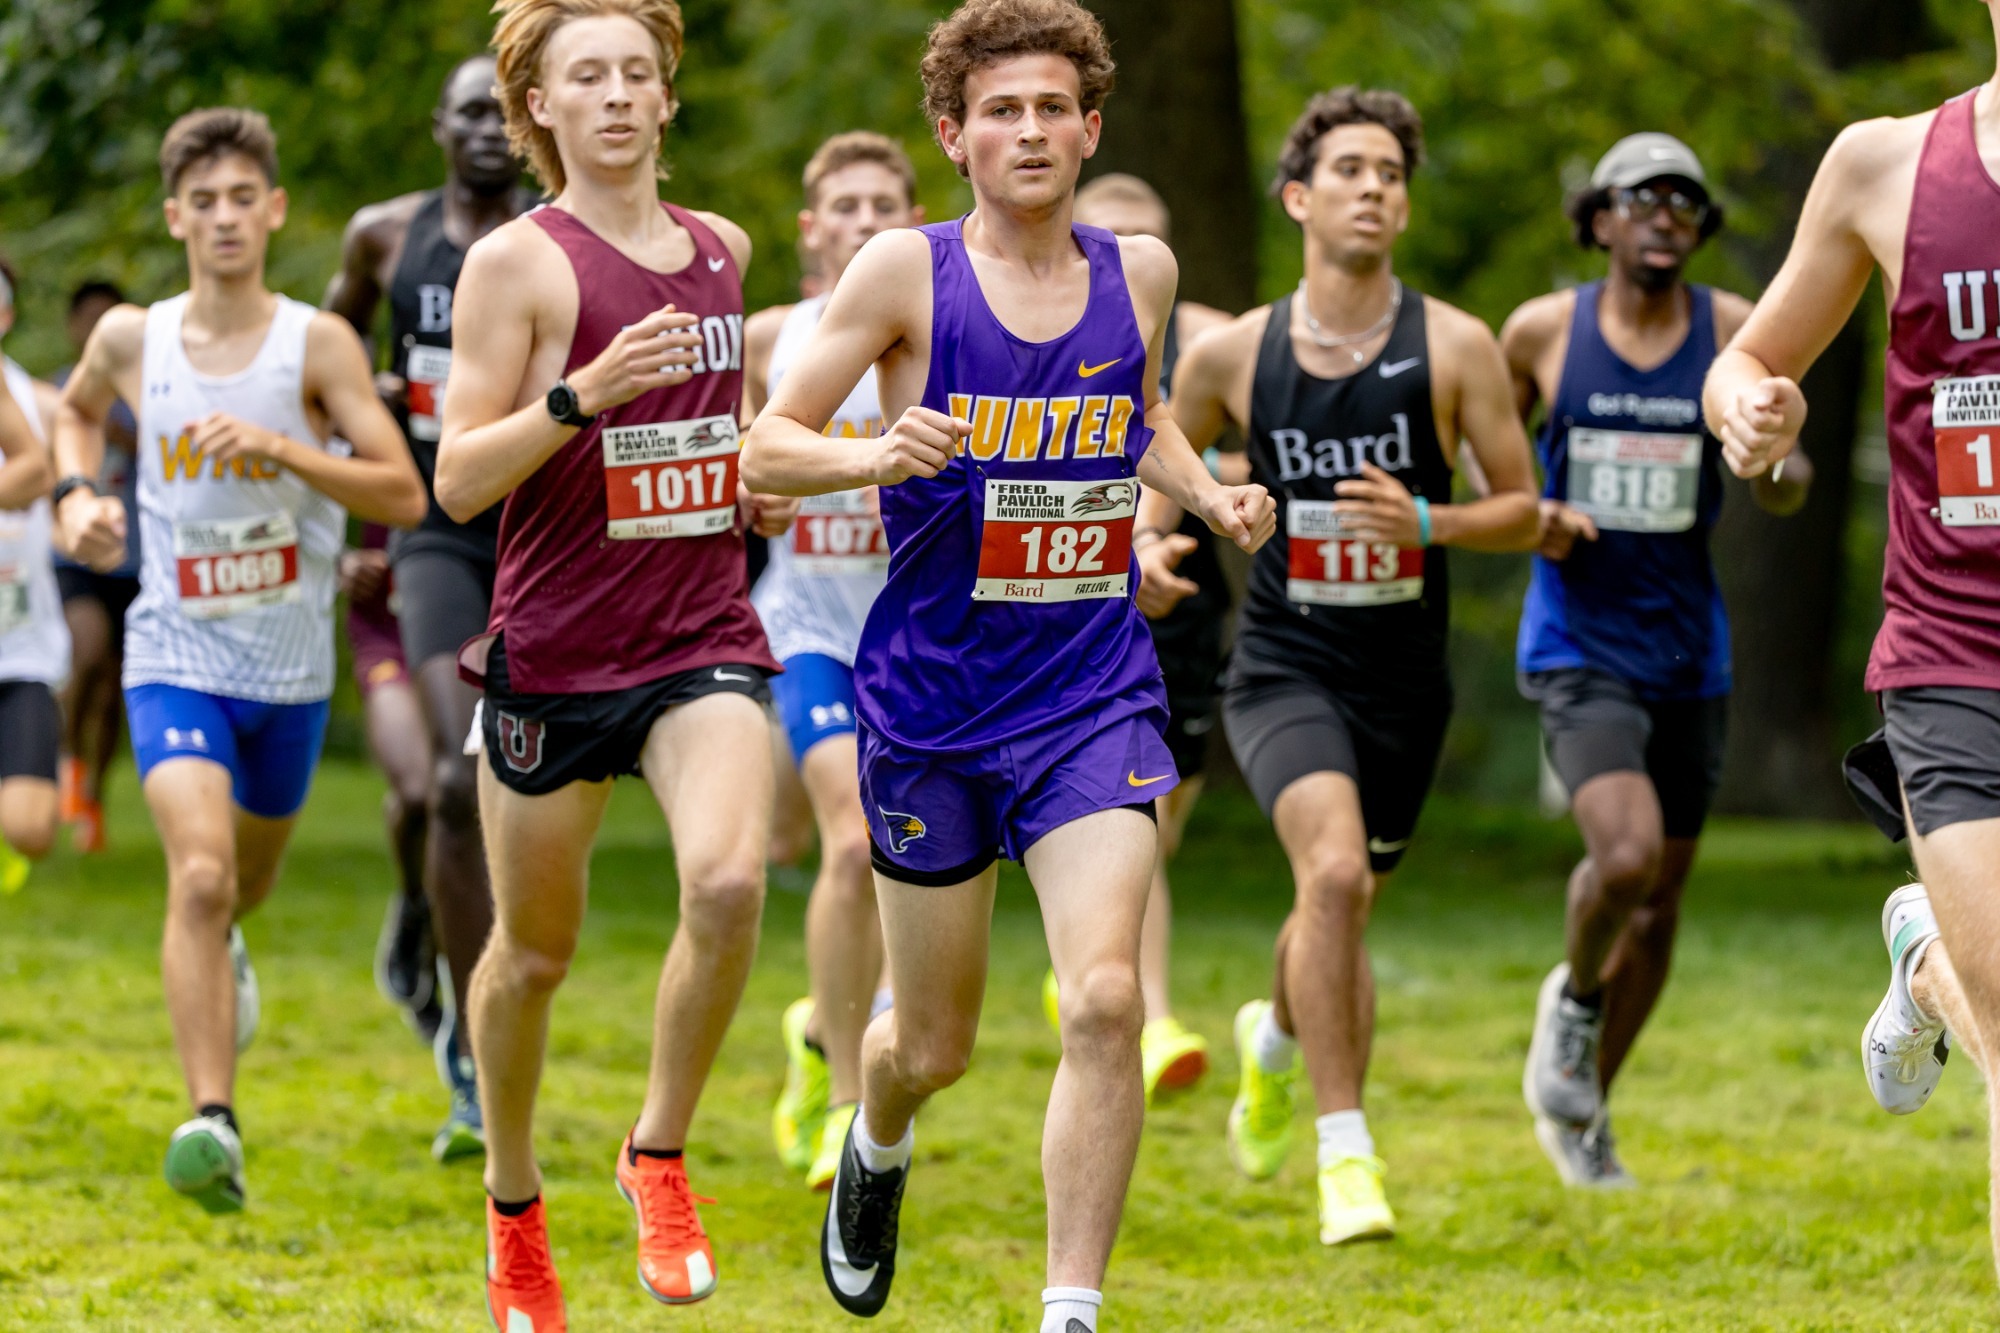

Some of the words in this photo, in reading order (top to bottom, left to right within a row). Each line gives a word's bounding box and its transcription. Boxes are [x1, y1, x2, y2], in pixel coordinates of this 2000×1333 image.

[1942, 269, 2000, 342] U
[1947, 393, 2000, 408] PAVLI
[1947, 409, 2000, 422] INVITATI
[614, 429, 659, 440] FRED
[614, 436, 677, 451] PAVLICH
[1269, 412, 1415, 482] Bard
[615, 449, 679, 462] INVITATIONAL
[631, 461, 727, 511] 1017
[998, 484, 1047, 494] FRED
[1589, 465, 1677, 511] 818
[997, 495, 1065, 507] PAVLICH
[996, 507, 1066, 518] INVITATIONAL
[635, 519, 673, 535] Bard
[1020, 525, 1108, 573] 182
[1316, 540, 1399, 582] 113
[191, 550, 285, 596] 1069
[1003, 583, 1044, 598] Bard
[1074, 581, 1112, 595] FAT.LIVE
